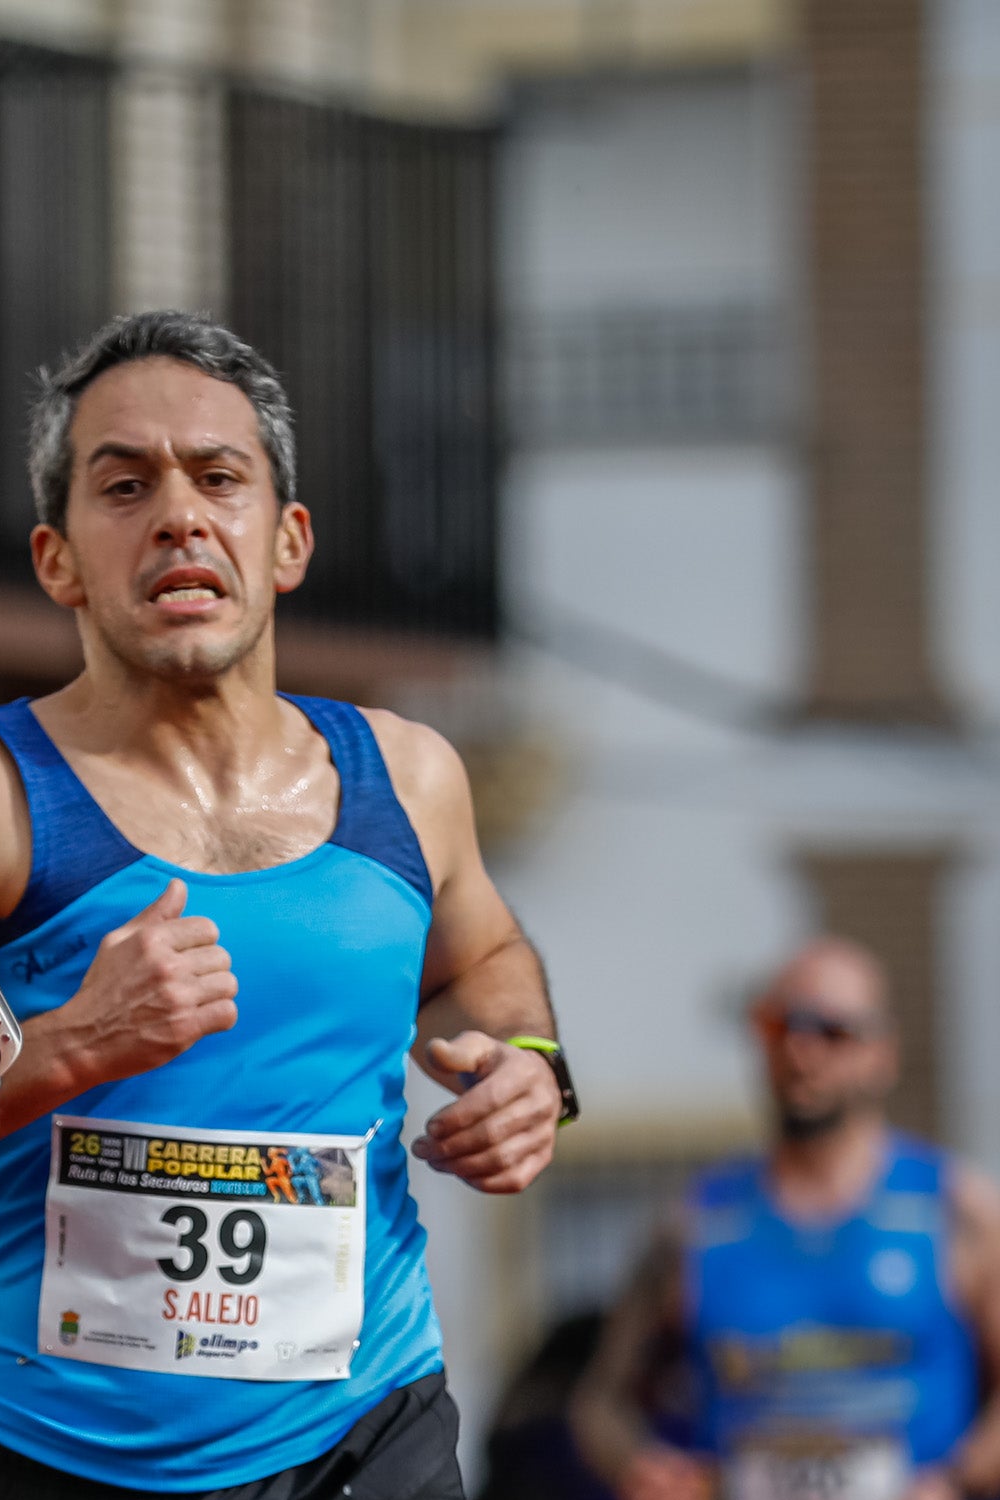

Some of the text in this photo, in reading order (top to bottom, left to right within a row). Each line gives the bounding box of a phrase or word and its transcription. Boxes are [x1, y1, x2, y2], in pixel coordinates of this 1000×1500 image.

[70, 1132, 100, 1155] 26
[148, 1140, 260, 1165] CARRERA
[147, 1158, 261, 1180] POPULAR
[157, 1205, 267, 1285] 39
[162, 1289, 260, 1326] S.ALEJO
[200, 1334, 259, 1354] olimpo
